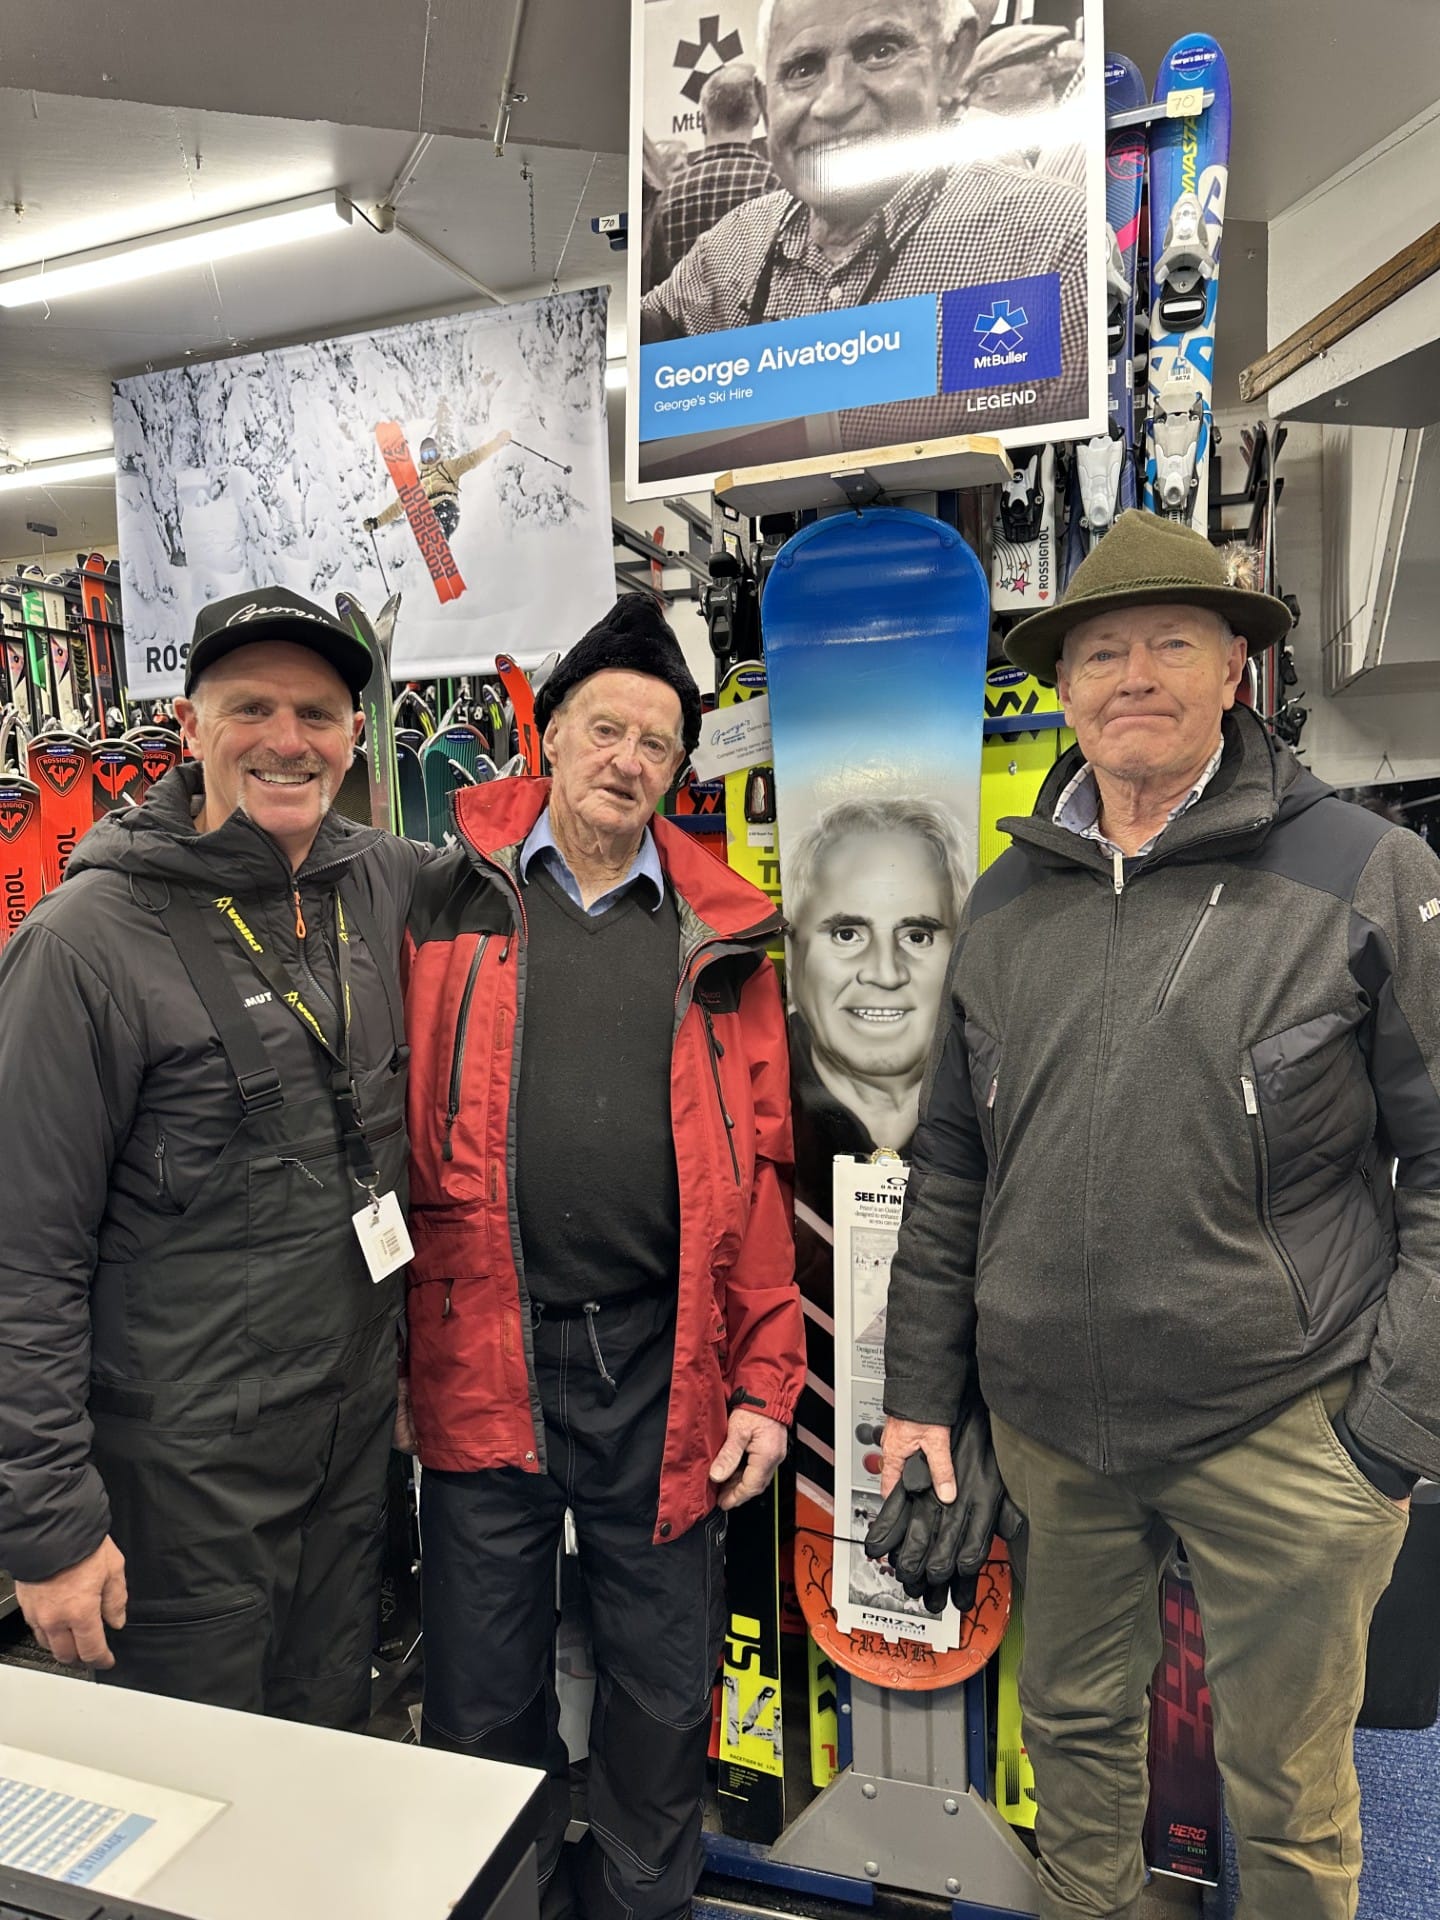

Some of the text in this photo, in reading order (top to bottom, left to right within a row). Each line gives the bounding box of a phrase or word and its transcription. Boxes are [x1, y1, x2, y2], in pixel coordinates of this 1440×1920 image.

[1171, 95, 1195, 110] 70
[654, 329, 901, 389] George Aivatoglou
[654, 386, 753, 413] George's Ski Hire
[967, 389, 1037, 412] LEGEND
[1039, 526, 1049, 590] ROSSIGNOL
[371, 702, 381, 784] ATOMIC
[854, 1191, 901, 1205] SEE IT IN
[862, 1612, 926, 1631] PRIZM
[1168, 1823, 1208, 1842] HERO
